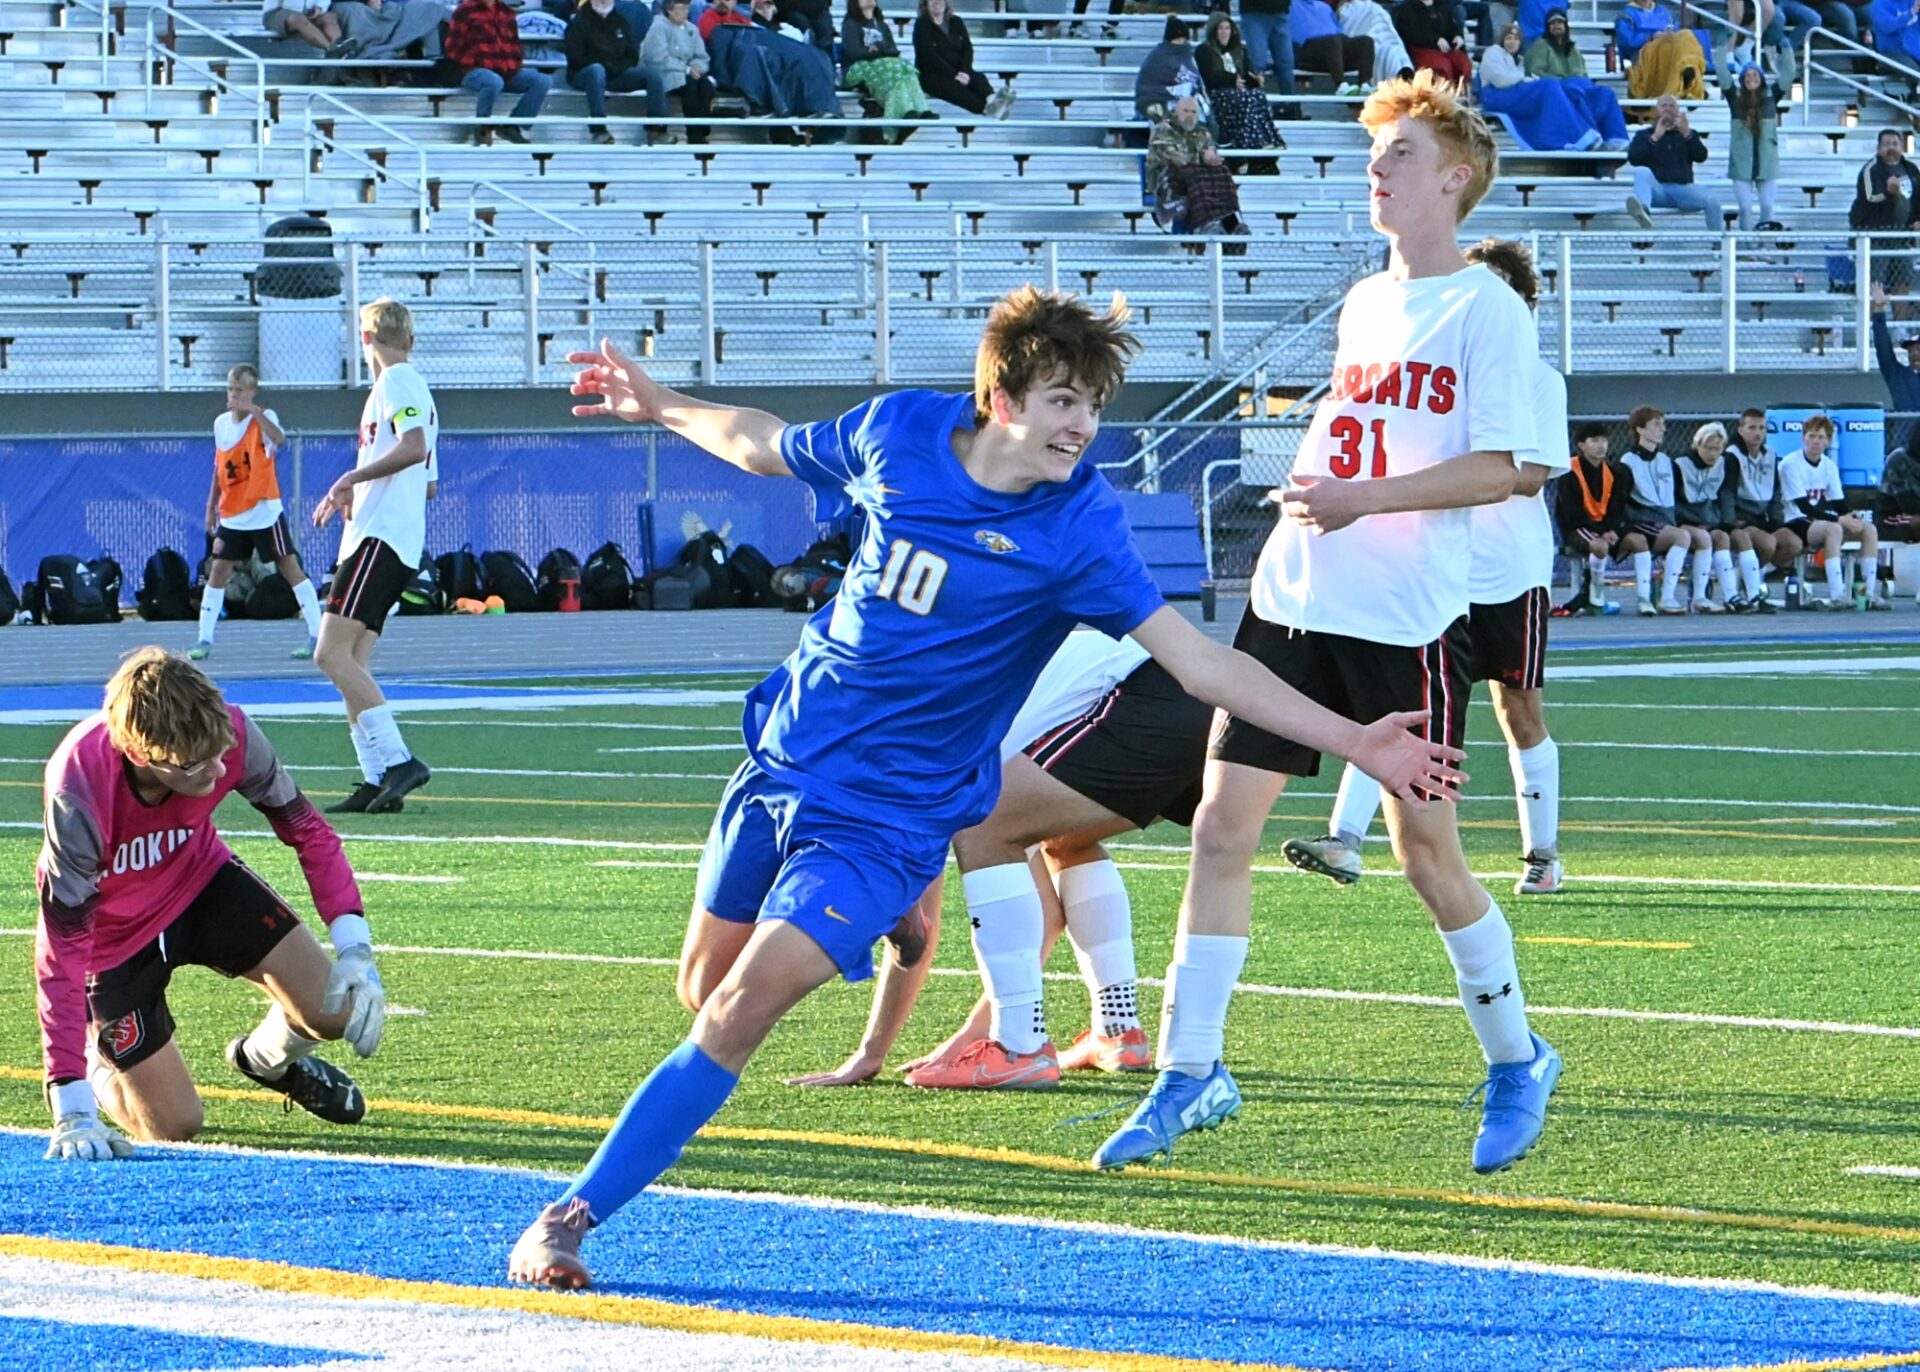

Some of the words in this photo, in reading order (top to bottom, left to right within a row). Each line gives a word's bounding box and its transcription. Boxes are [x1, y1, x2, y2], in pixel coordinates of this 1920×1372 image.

[405, 407, 417, 417] C
[1329, 416, 1387, 479] 31
[876, 538, 949, 616] 10
